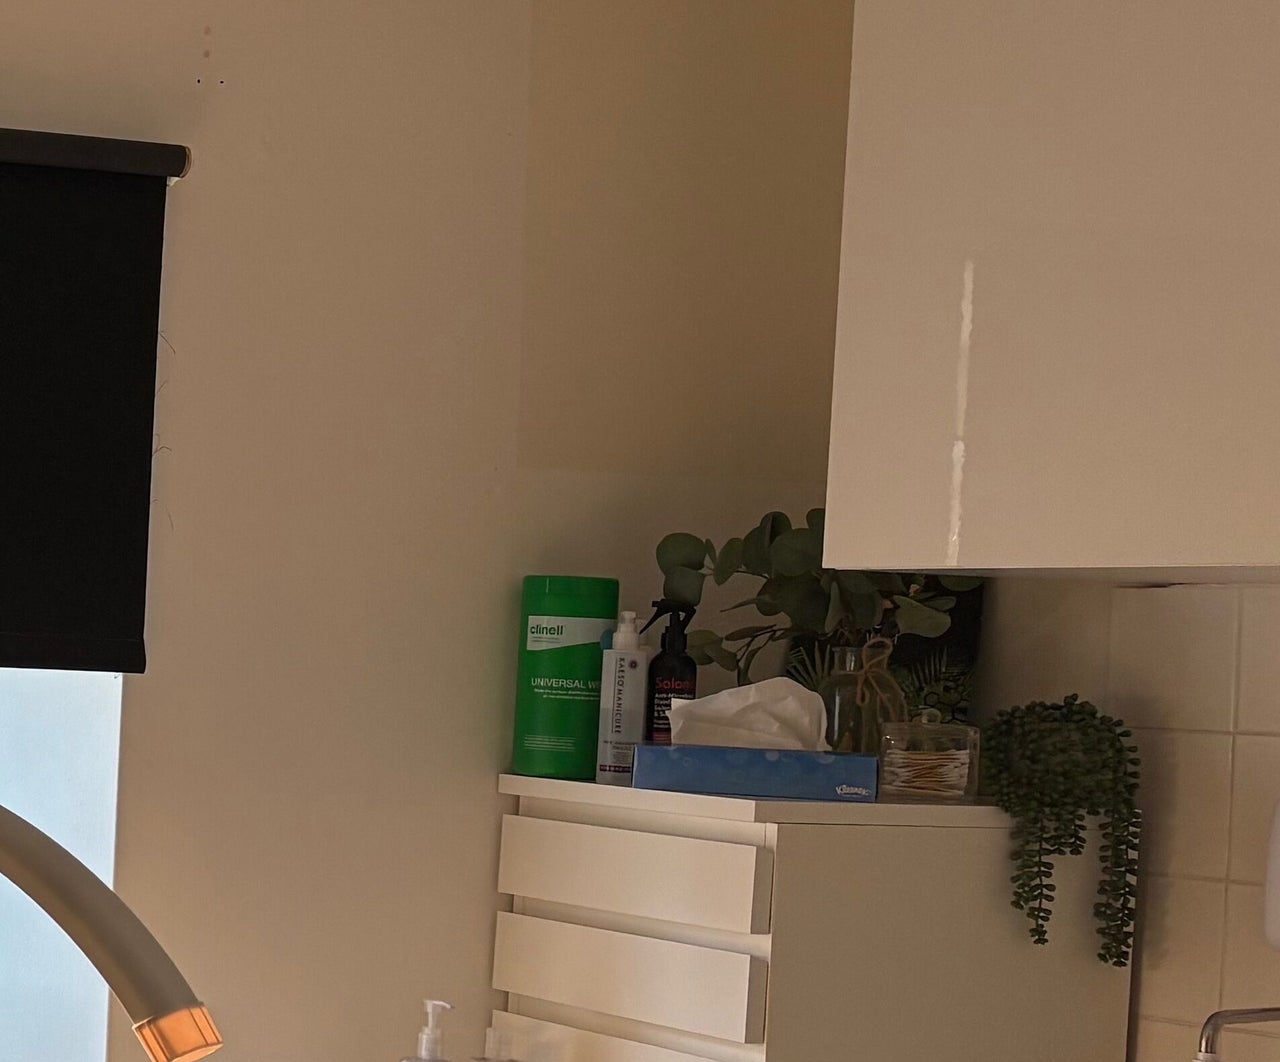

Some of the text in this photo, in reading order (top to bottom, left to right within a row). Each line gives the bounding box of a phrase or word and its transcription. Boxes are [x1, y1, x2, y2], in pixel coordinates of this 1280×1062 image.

[530, 625, 563, 635] clinell
[532, 678, 586, 688] UNIVERSAL
[615, 689, 623, 733] MANICURE
